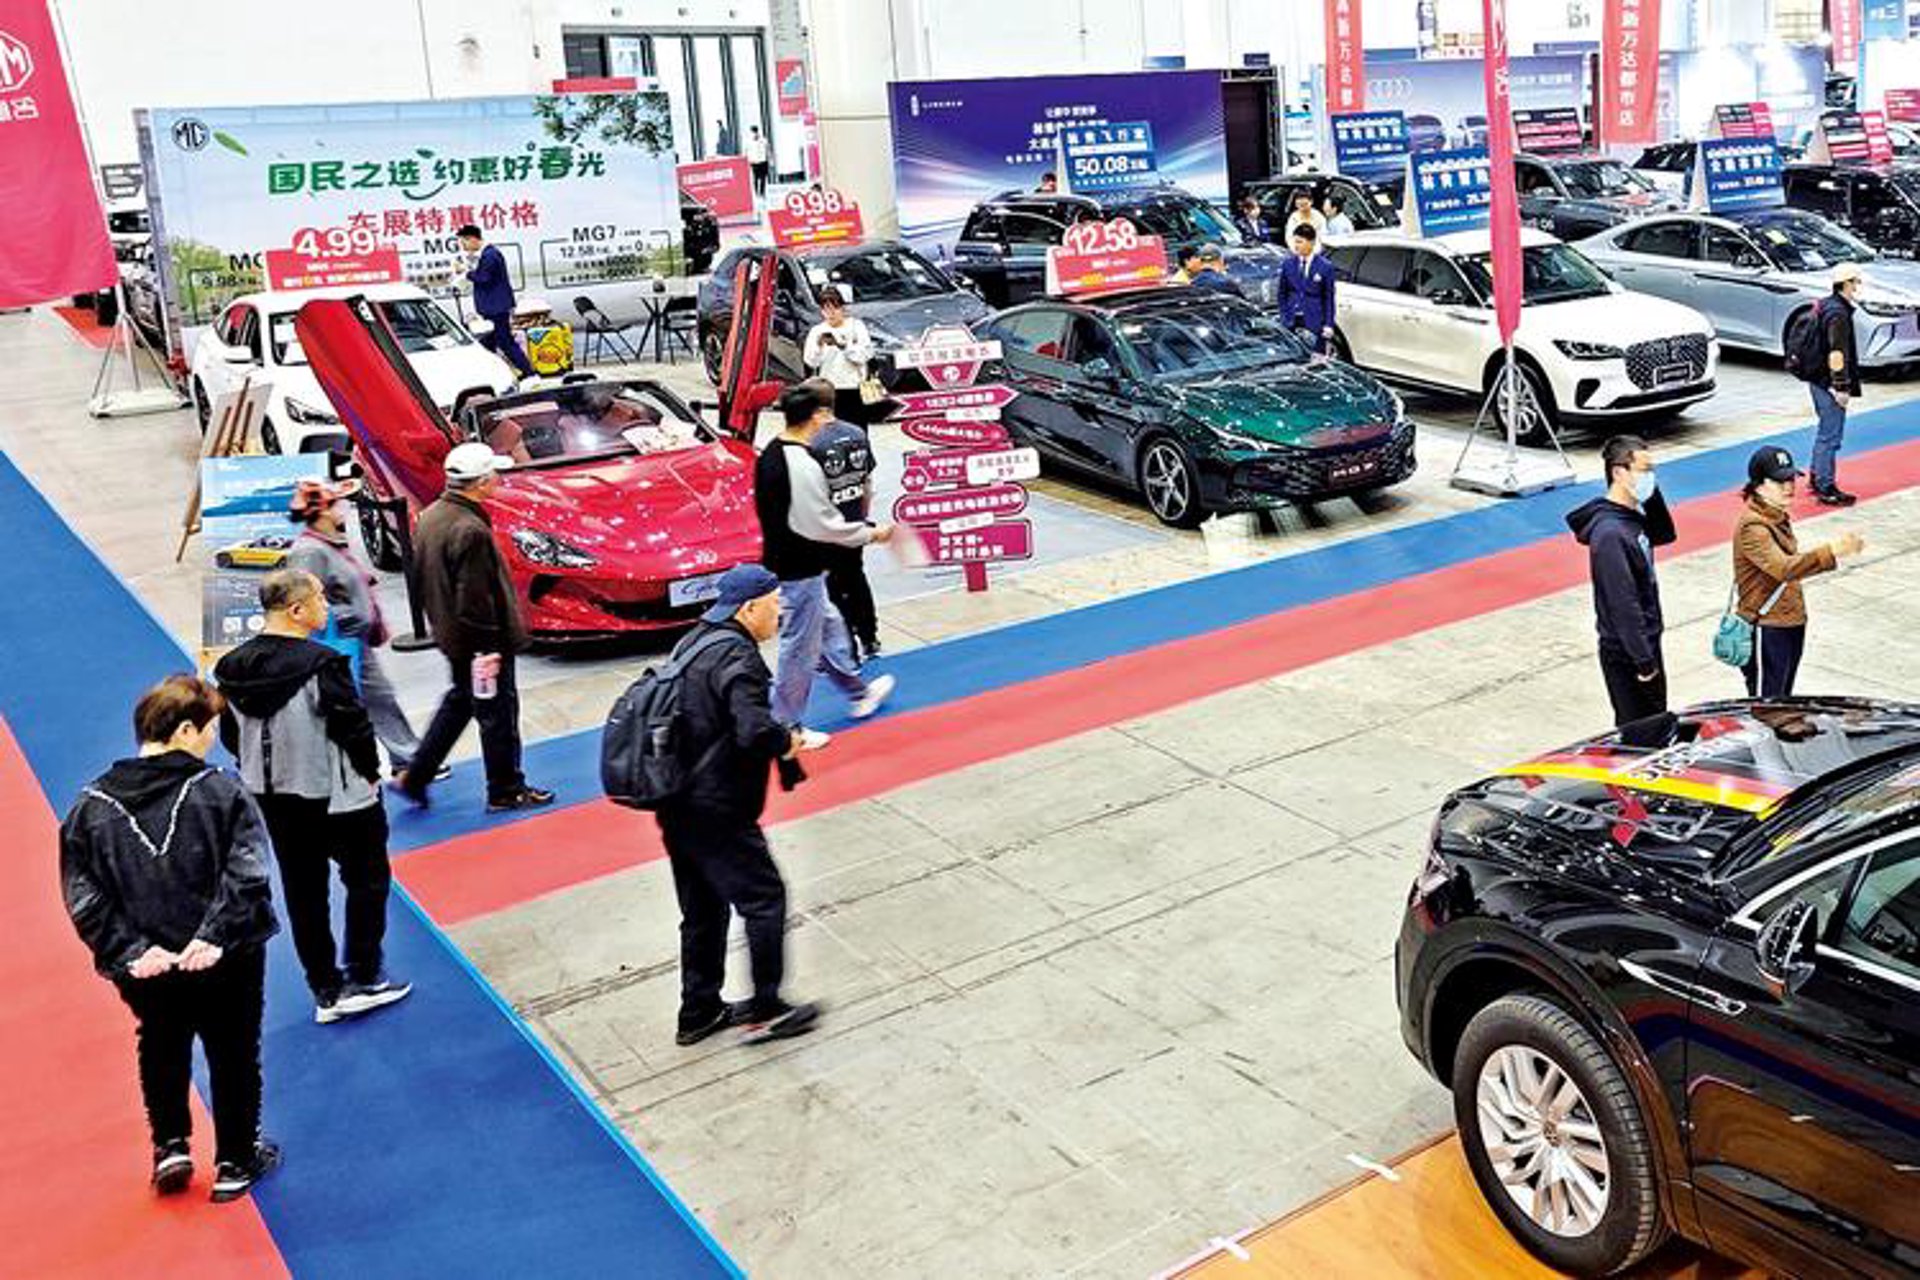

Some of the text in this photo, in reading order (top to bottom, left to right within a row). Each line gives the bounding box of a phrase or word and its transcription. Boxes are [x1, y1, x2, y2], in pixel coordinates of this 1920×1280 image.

[172, 119, 209, 149] MG
[268, 146, 606, 195] 国民之选 约惠好春光
[1075, 156, 1128, 176] 50.08
[787, 191, 842, 217] 9.98
[347, 200, 540, 239] 在展特惠价格
[572, 225, 616, 242] MG7
[296, 229, 375, 258] 4.99
[1069, 220, 1137, 256] 12.58
